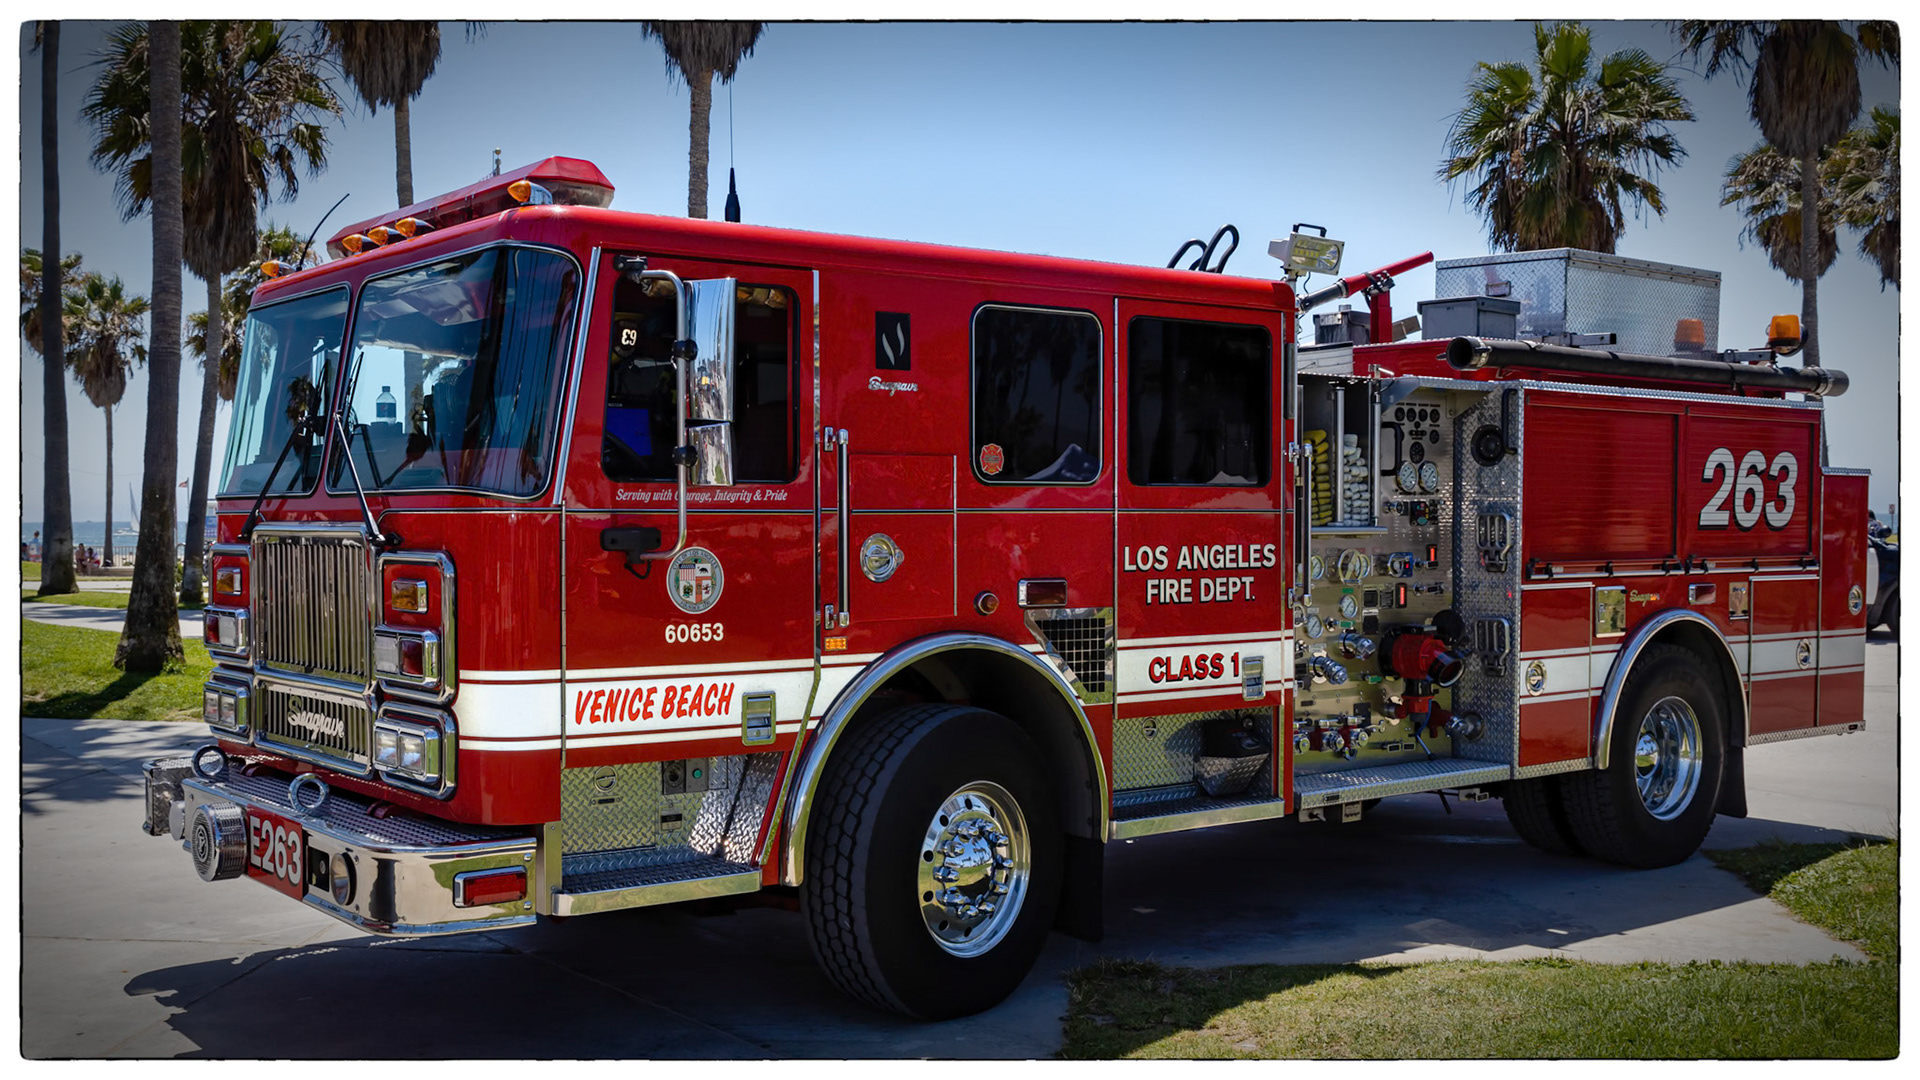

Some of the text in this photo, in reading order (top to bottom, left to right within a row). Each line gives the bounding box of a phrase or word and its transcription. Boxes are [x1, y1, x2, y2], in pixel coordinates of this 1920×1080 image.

[615, 488, 788, 504] Serving with Curage, Integrity & Pride
[1697, 447, 1799, 533] 263
[1123, 543, 1277, 572] LOS ANGELES
[1146, 576, 1256, 605] FIRE DEPT.
[664, 622, 724, 644] 60653
[1148, 651, 1240, 684] CLASS 1
[287, 694, 345, 742] Seagrave
[575, 682, 735, 726] VENICE BEACH
[249, 815, 302, 886] E263
